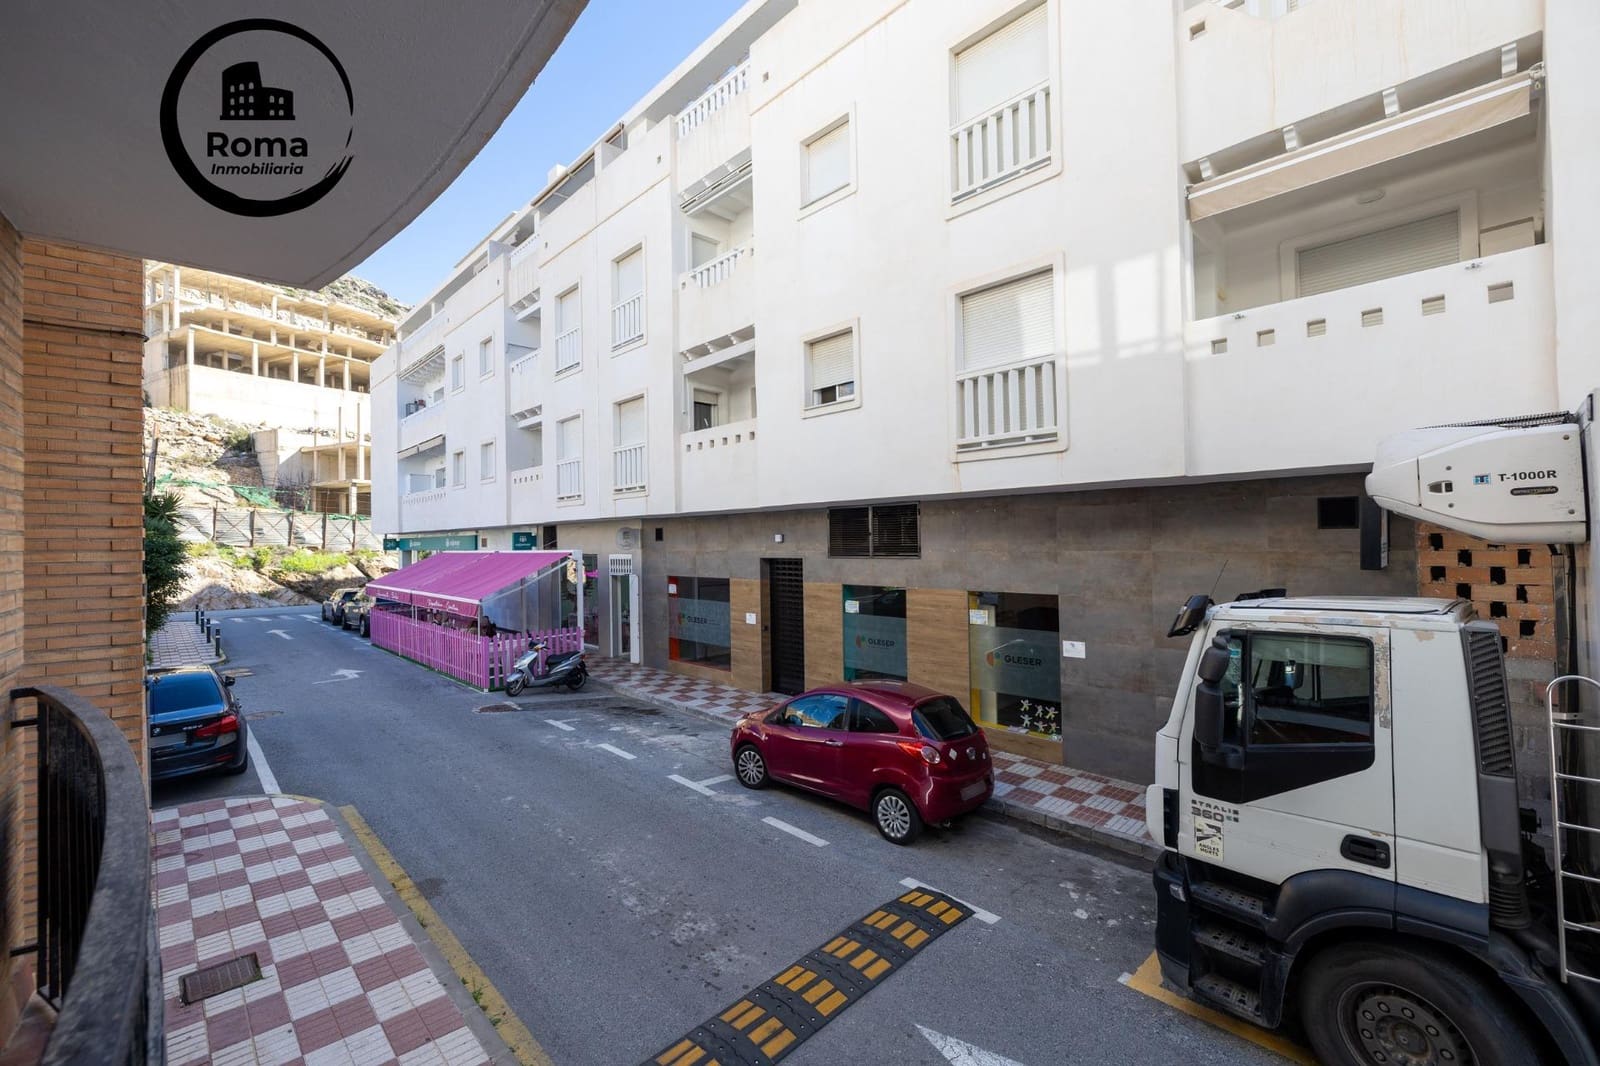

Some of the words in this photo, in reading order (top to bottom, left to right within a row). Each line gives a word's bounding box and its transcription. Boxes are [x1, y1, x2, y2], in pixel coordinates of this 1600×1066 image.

[1498, 470, 1557, 481] T-1000R
[1004, 655, 1042, 667] GLESER
[1191, 799, 1240, 815] STRALIS
[1191, 806, 1225, 822] 360
